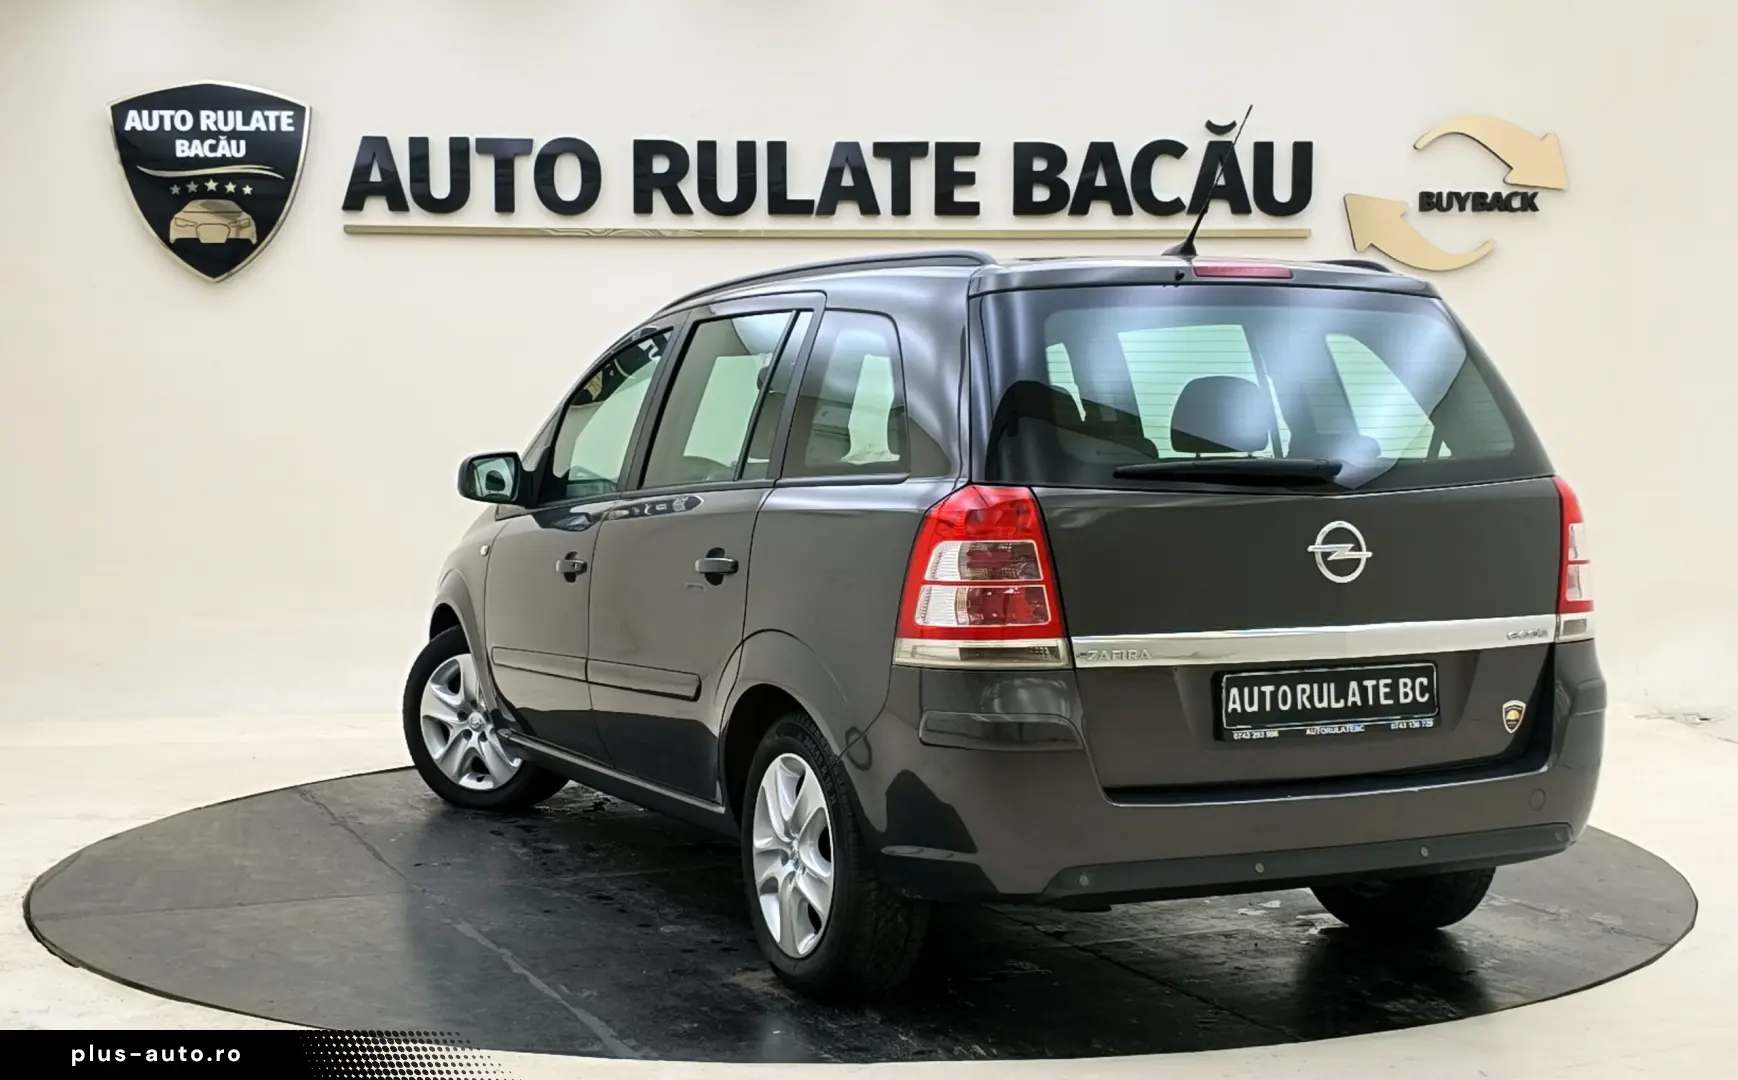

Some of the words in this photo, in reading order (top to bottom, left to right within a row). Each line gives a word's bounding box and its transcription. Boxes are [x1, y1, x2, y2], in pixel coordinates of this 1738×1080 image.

[124, 110, 194, 132] AUTO
[200, 110, 295, 133] RULATE
[175, 136, 246, 158] BACĂU
[341, 136, 602, 215] AUTO
[632, 138, 981, 217] RULATE
[1012, 119, 1313, 217] BACĂU
[1418, 191, 1540, 213] BUYBACK
[1087, 649, 1152, 661] ZAFIRA
[1227, 685, 1292, 713] AUTO
[1296, 678, 1394, 710] RULATE
[1398, 677, 1430, 704] BC
